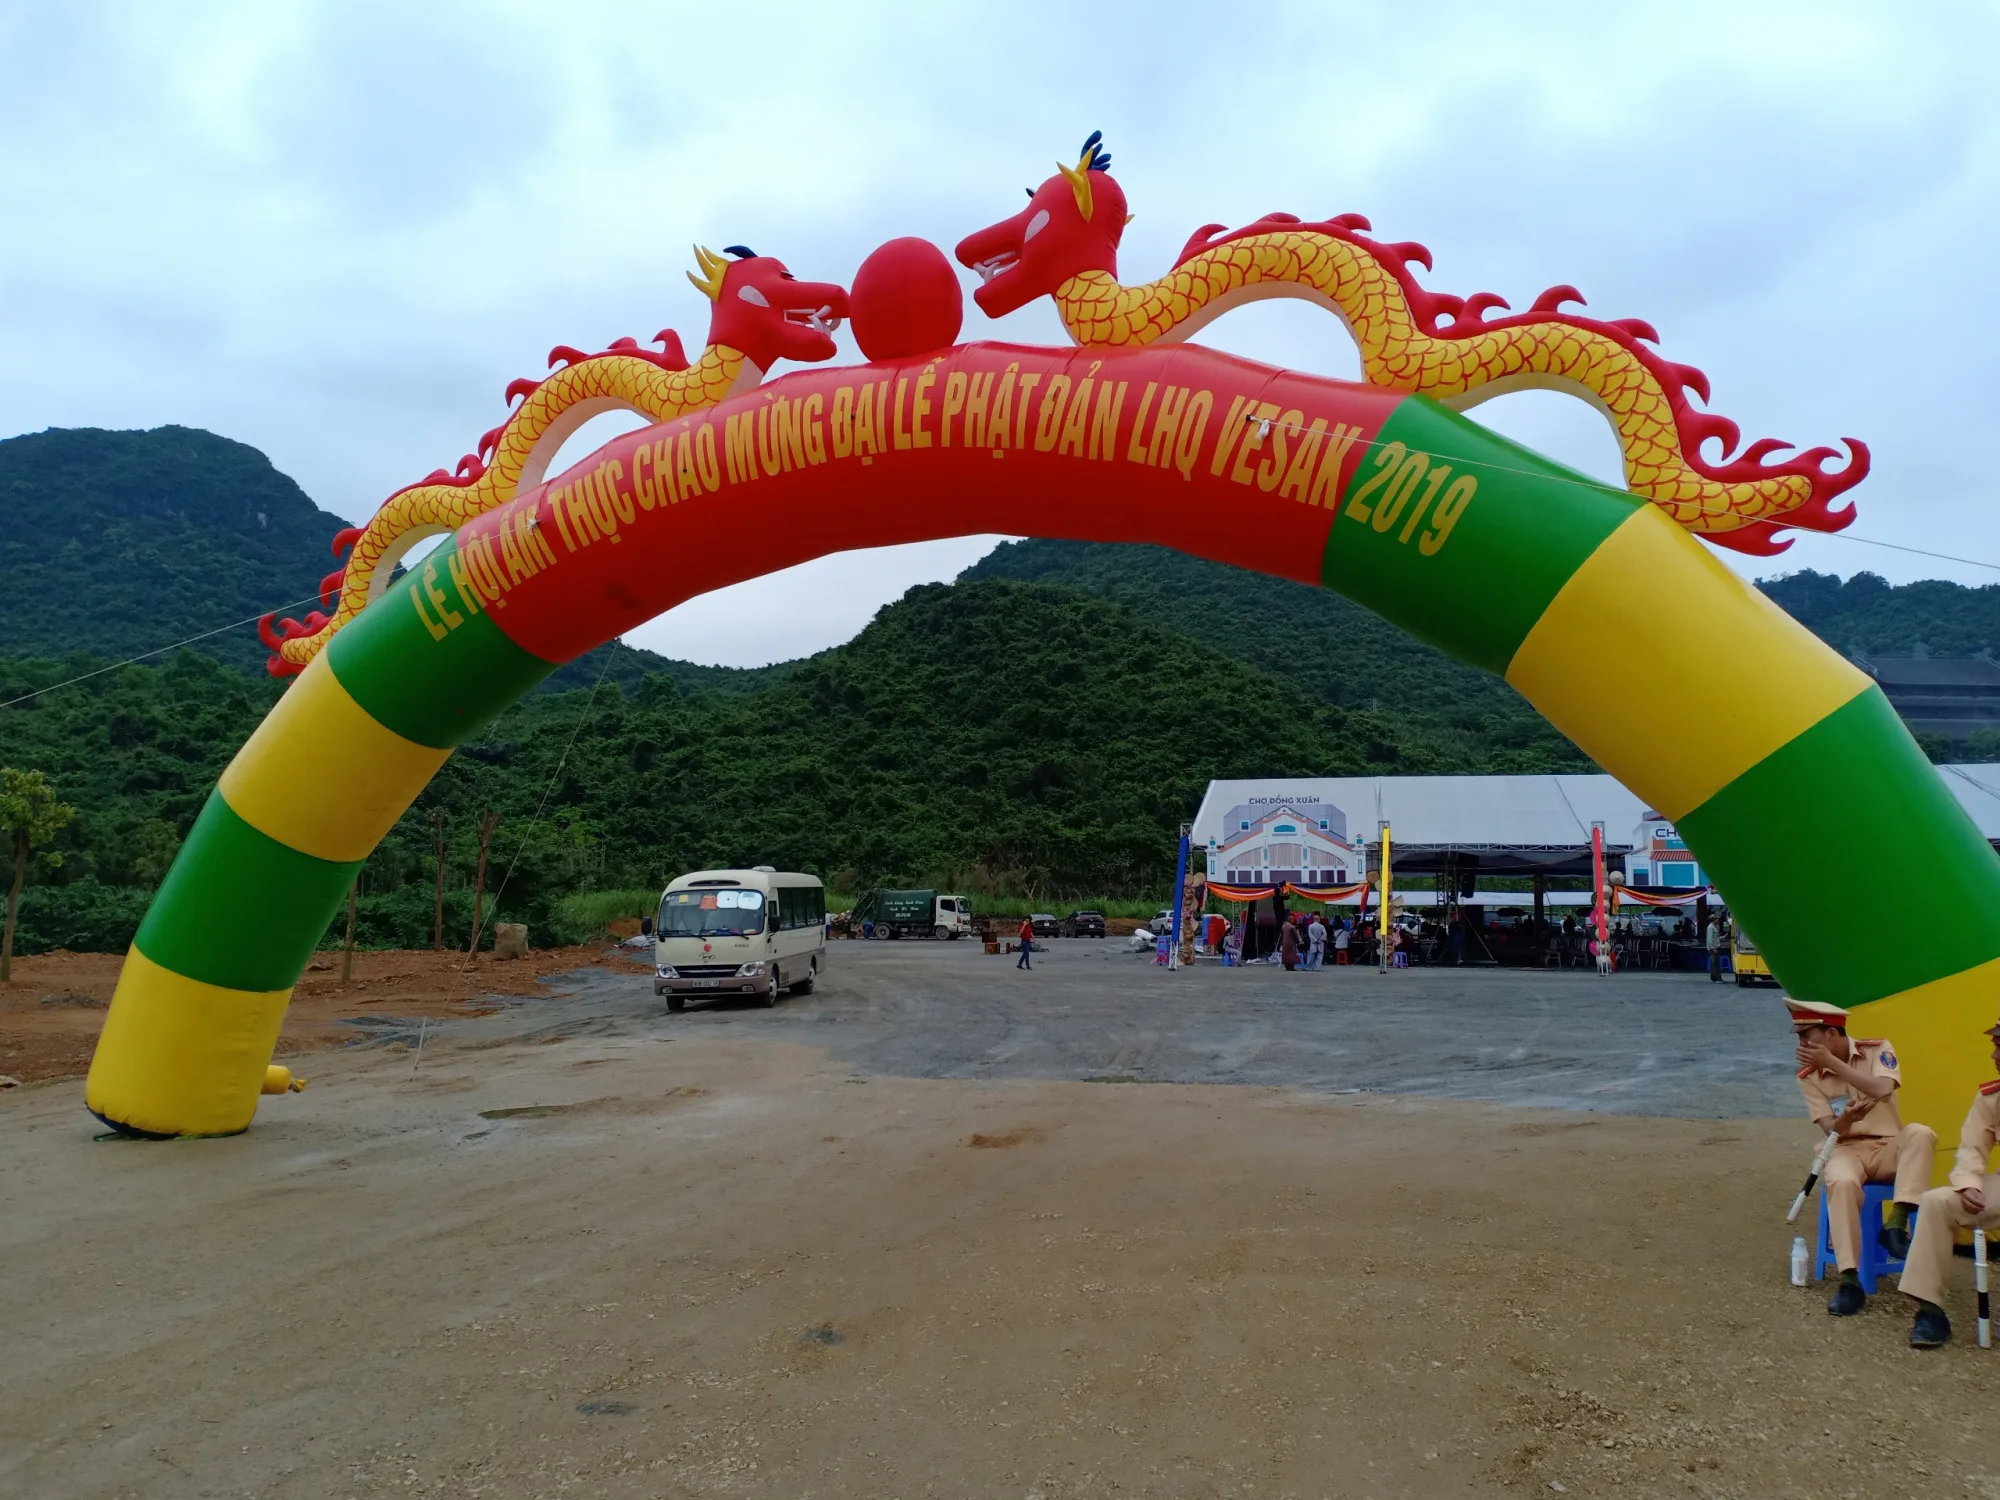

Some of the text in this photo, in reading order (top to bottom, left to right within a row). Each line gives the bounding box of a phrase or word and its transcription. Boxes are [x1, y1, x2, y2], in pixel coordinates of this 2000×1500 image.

[448, 529, 512, 609] HỘI
[500, 499, 557, 586] ẨM
[547, 459, 635, 553] THỰC
[633, 421, 720, 511] CHÀO
[724, 392, 827, 484] MỪNG
[830, 380, 888, 466] ĐẠI
[893, 356, 946, 450] LỄ
[941, 362, 1042, 459] PHẬT
[1034, 360, 1129, 461] ĐẢN
[1127, 381, 1214, 482] LHQ
[1210, 395, 1364, 510] VESAK
[1344, 441, 1478, 556] 2019
[1655, 828, 1682, 838] CH
